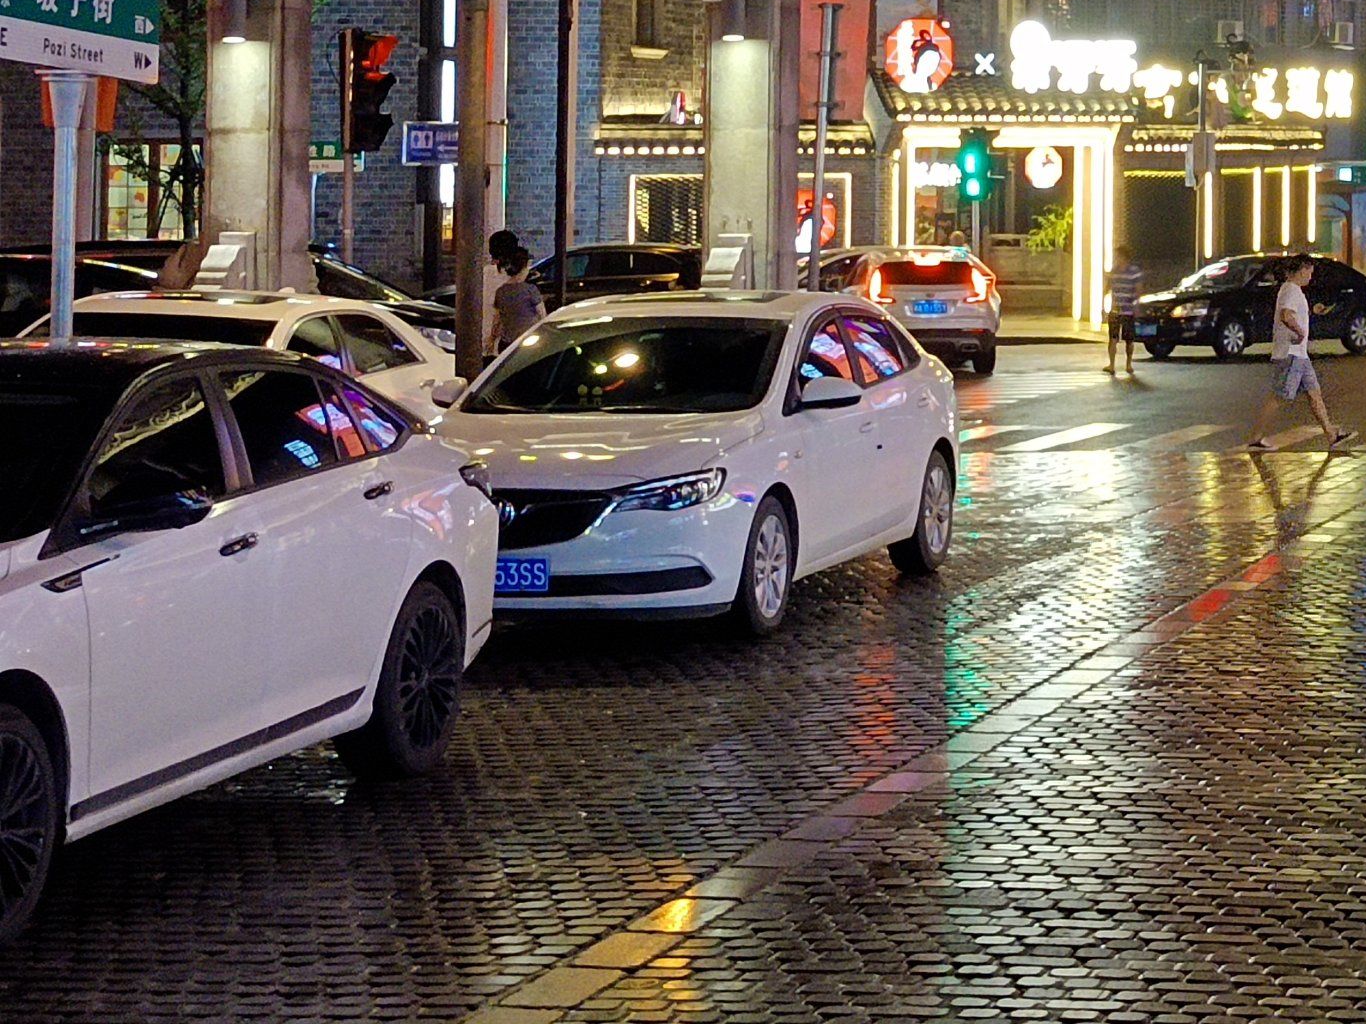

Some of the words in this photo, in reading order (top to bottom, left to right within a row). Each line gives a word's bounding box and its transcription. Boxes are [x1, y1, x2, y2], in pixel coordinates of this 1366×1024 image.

[43, 37, 67, 58] Pozi
[70, 42, 104, 63] Street
[134, 51, 144, 70] W
